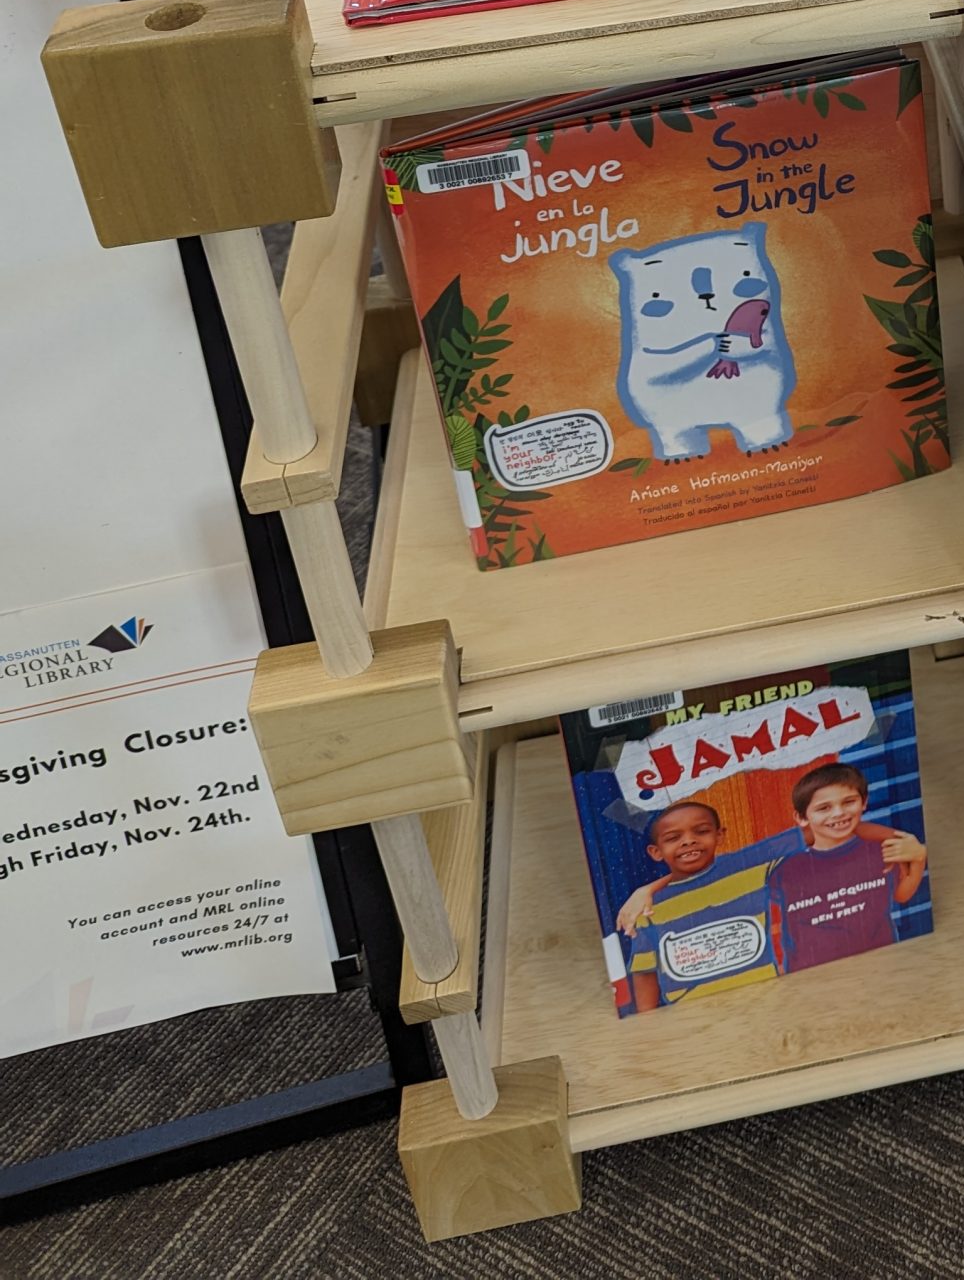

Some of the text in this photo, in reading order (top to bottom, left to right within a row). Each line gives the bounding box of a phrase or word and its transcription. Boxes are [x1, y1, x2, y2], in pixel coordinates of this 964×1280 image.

[706, 121, 818, 171] Snow
[493, 159, 624, 211] Nieve
[713, 163, 856, 218] Jungle
[757, 163, 814, 183] in the
[536, 199, 595, 222] en la
[501, 207, 640, 264] jungla
[503, 449, 533, 463] your
[629, 455, 823, 503] Ariane Hofmann-Maniyar
[24, 657, 114, 688] LIBRARY
[665, 680, 815, 727] MY FRIEND
[123, 717, 248, 754] Closure:
[636, 699, 861, 790] JAMAL
[133, 791, 190, 815] Nov.
[197, 775, 260, 802] 22nd
[30, 840, 118, 868] Friday,
[125, 824, 181, 848] Nov.
[187, 808, 251, 833] 24th.
[68, 877, 281, 930] You can access your online
[100, 895, 285, 941] account and MRL online
[787, 895, 822, 913] ANNA
[811, 902, 866, 926] BEN FREY
[830, 901, 846, 910] AND
[152, 912, 290, 947] resources 24/7 at
[181, 930, 293, 958] www.mrlib.org
